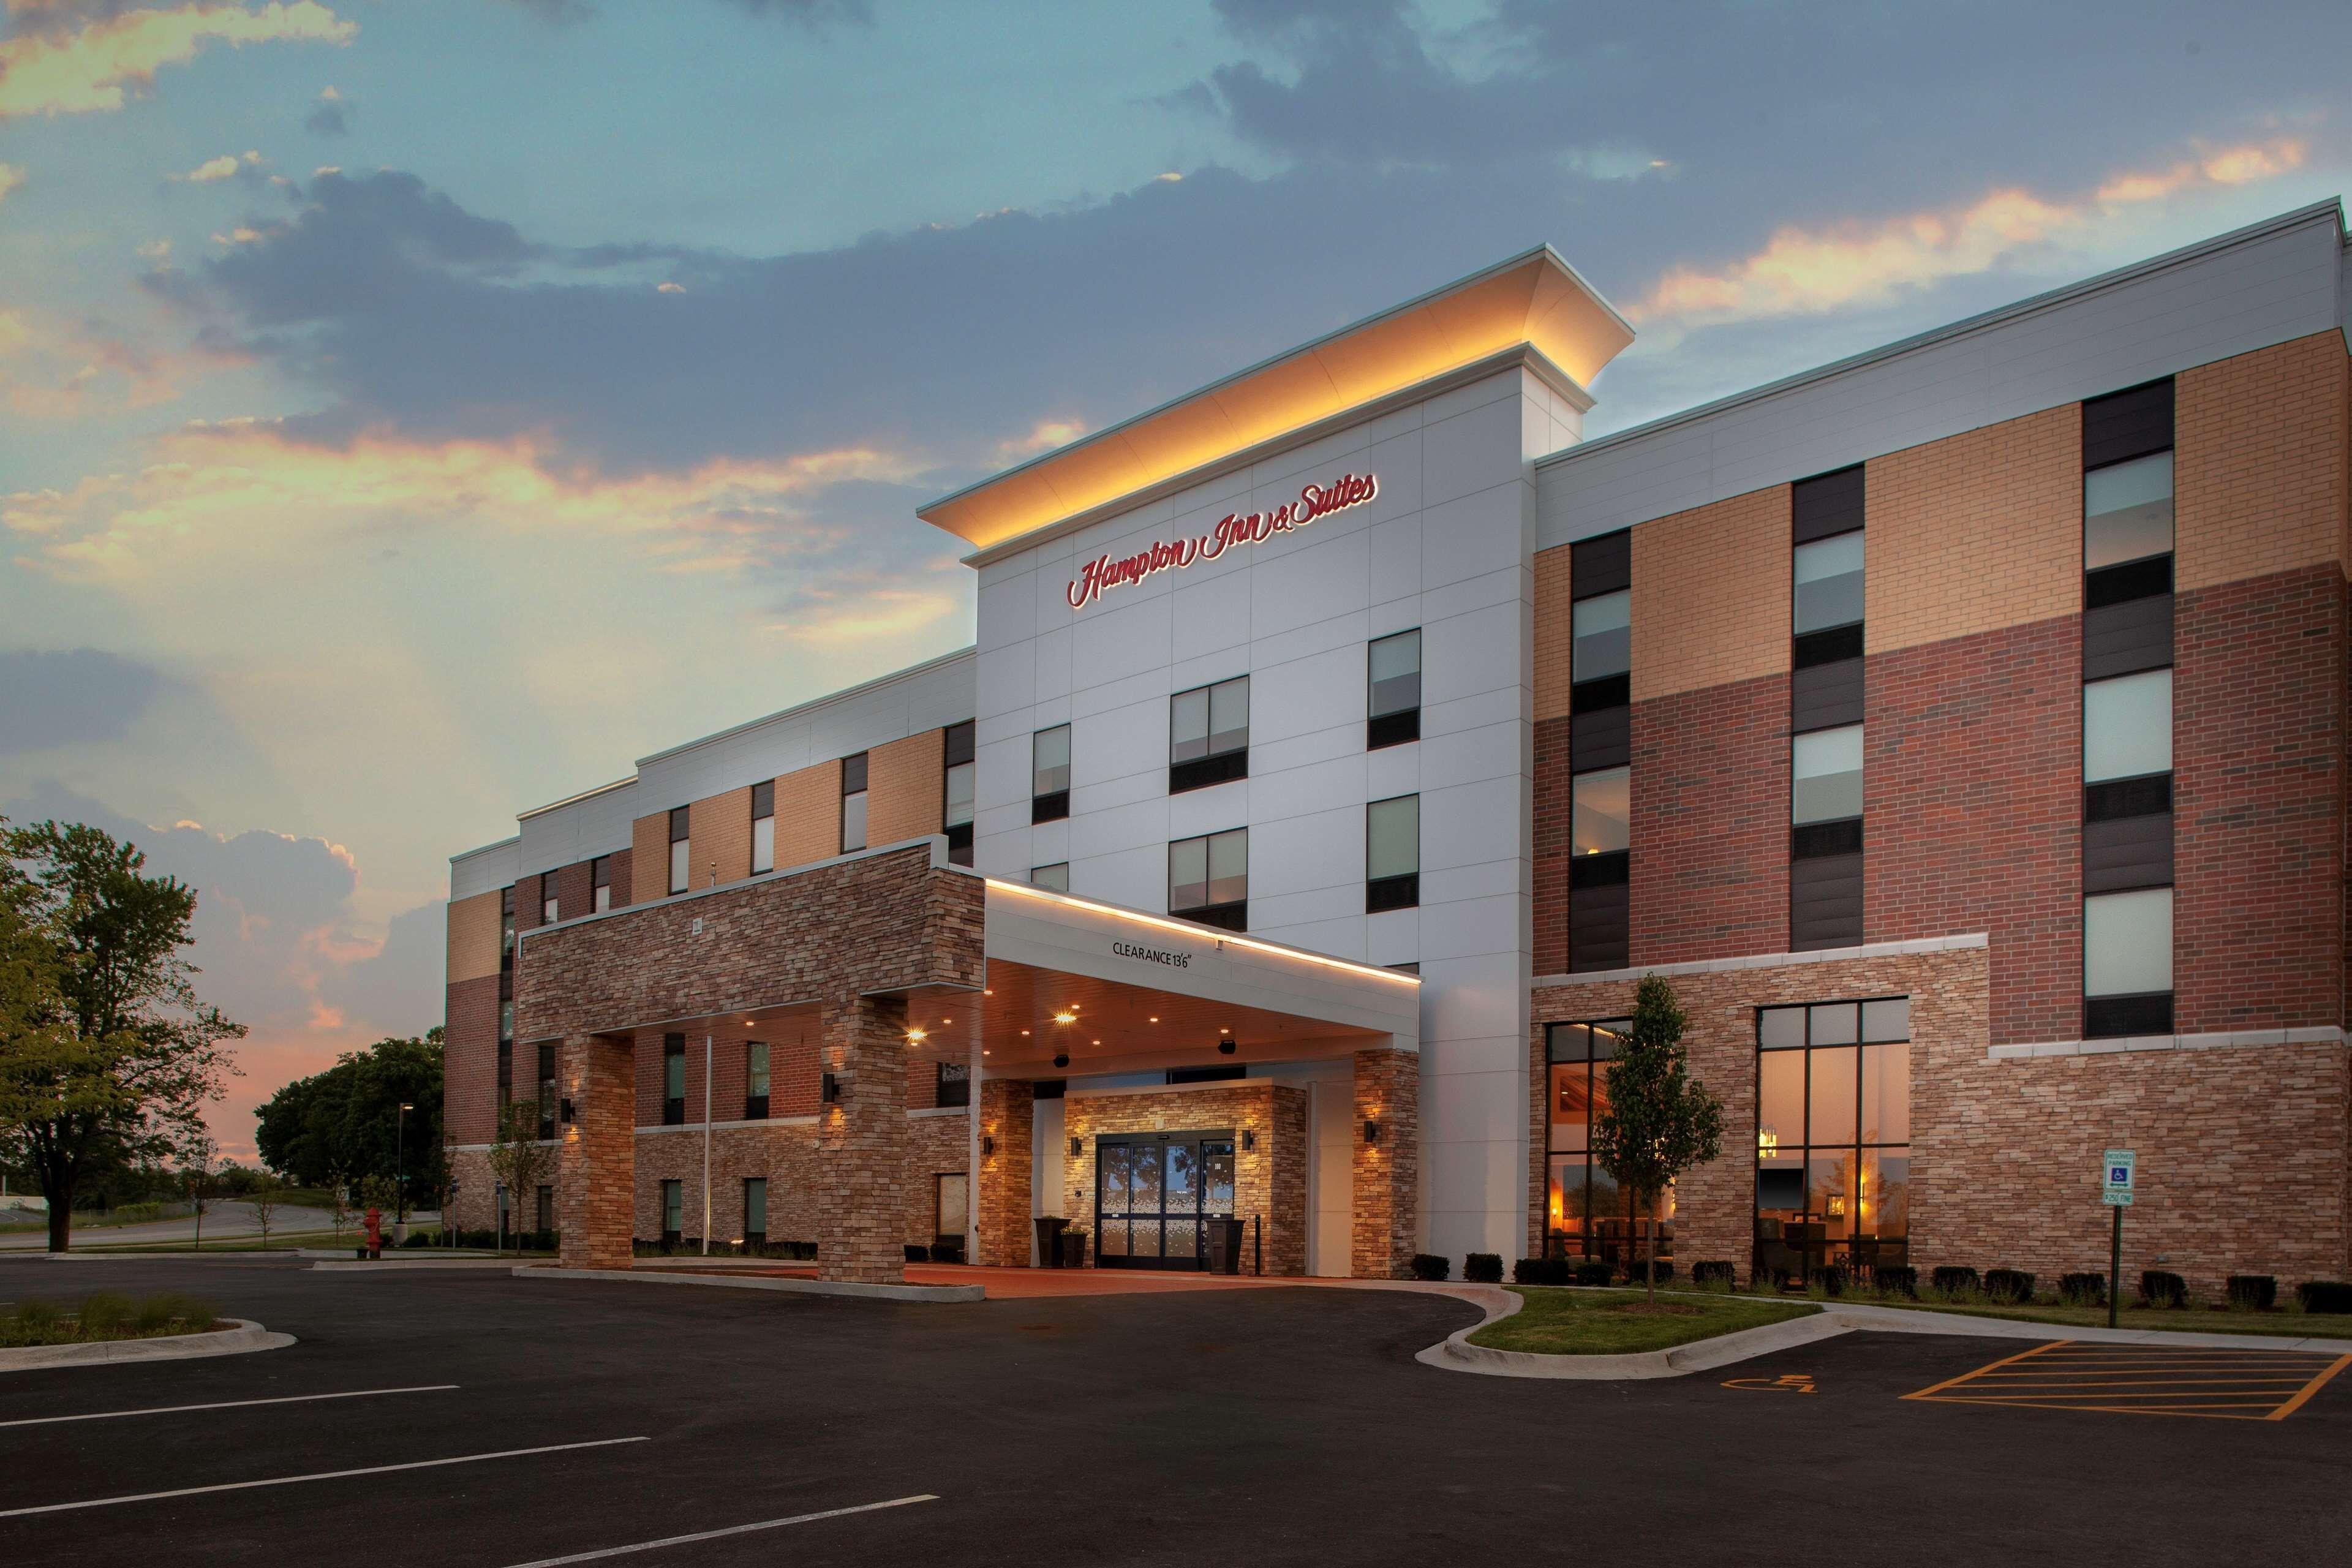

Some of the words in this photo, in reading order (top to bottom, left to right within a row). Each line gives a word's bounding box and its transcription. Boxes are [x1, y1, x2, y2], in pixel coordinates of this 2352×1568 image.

[1067, 538, 1198, 608] Hampton
[1199, 513, 1273, 559] Inn
[1272, 505, 1295, 532] &
[1290, 474, 1378, 524] Suites
[1113, 942, 1171, 965] CLEARANCE
[1172, 952, 1192, 968] 13'6"
